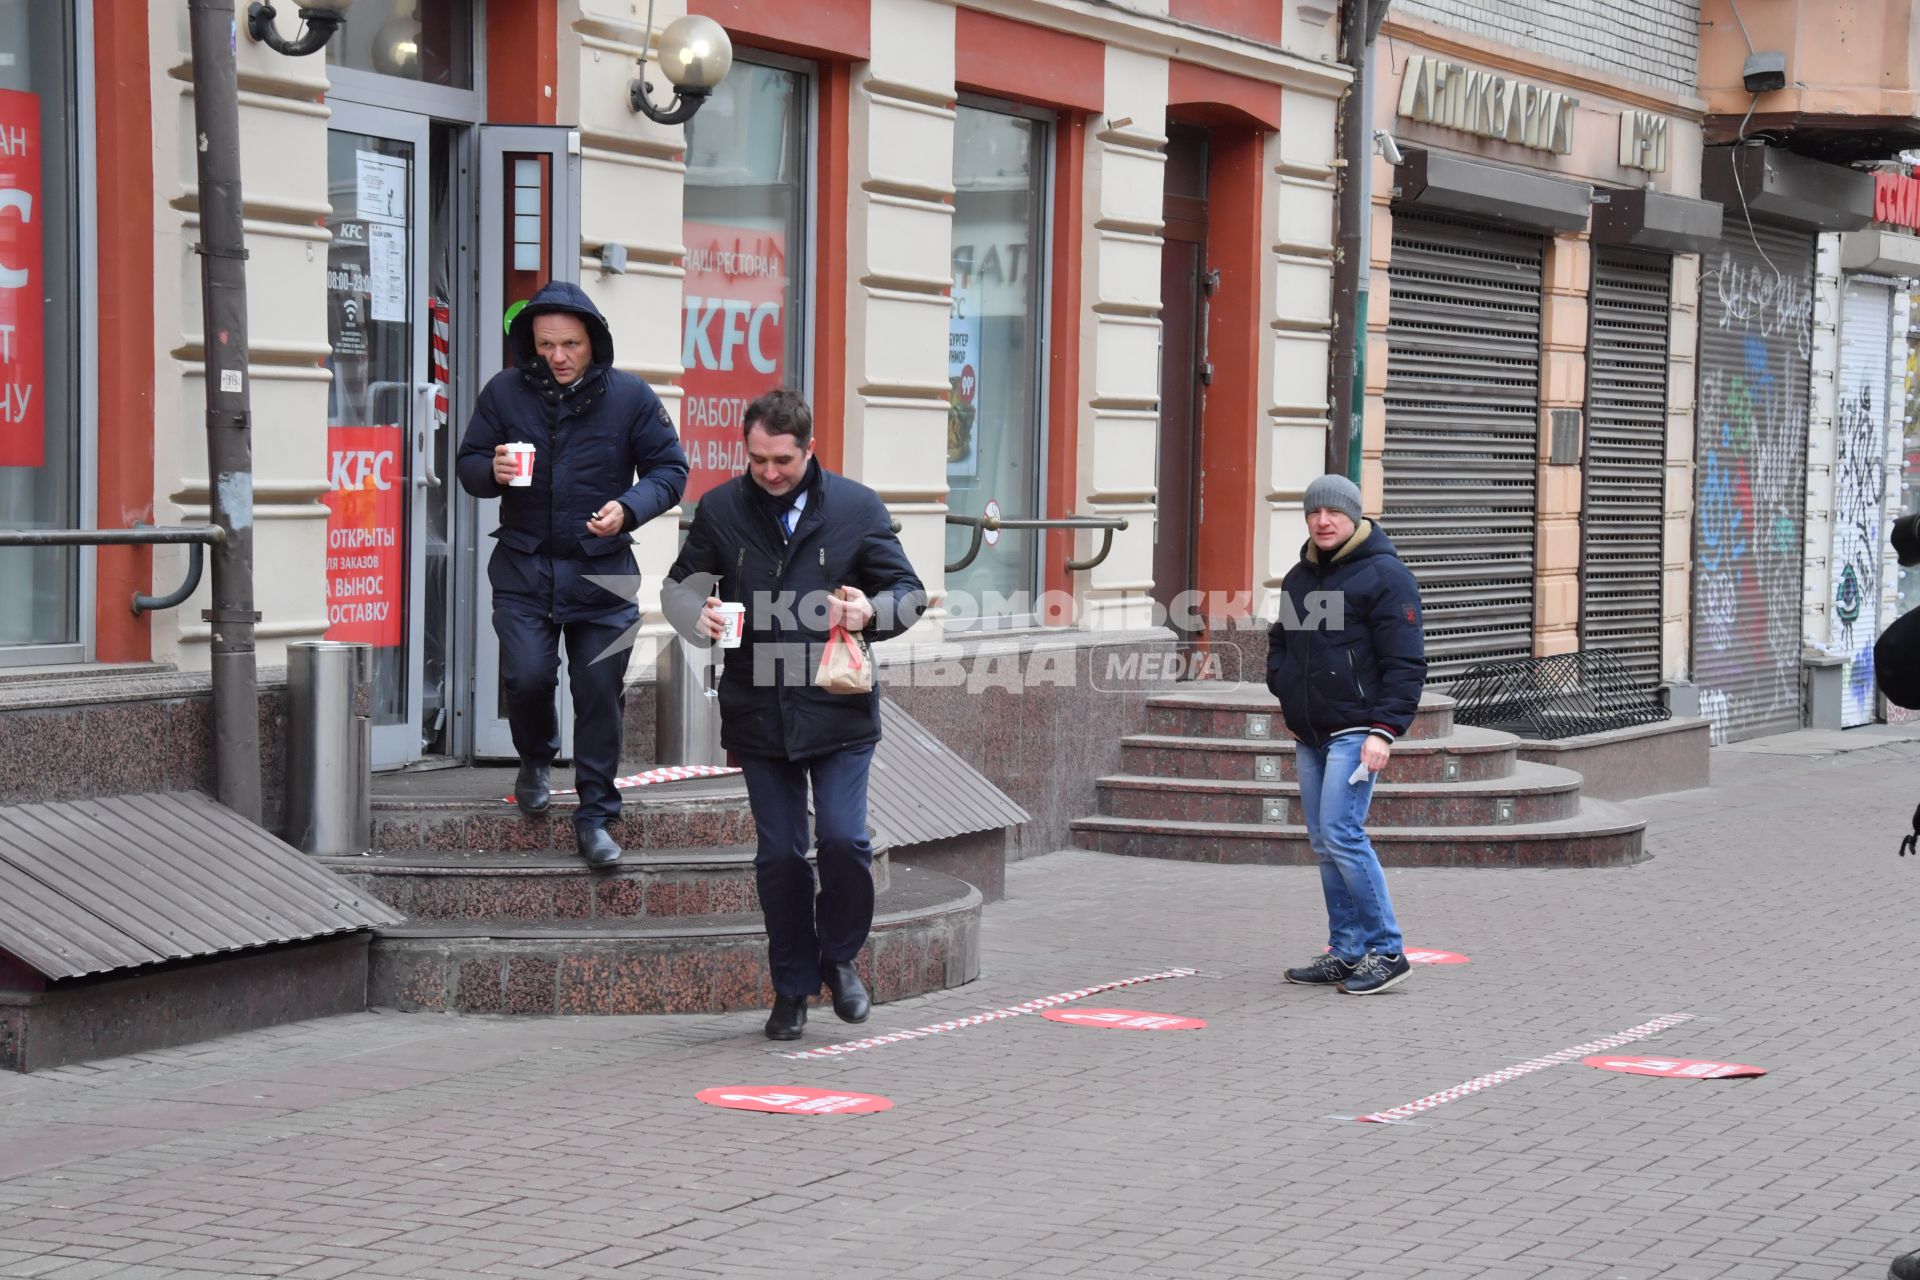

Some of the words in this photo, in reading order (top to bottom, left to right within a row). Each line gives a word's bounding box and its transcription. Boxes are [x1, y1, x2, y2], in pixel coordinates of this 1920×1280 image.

[1397, 55, 1579, 156] АНТИКВАРИАТ
[340, 223, 363, 240] KFC
[717, 251, 778, 280] РЕСТОРАН
[681, 295, 780, 374] KFC
[948, 332, 969, 349] БУРГЕР
[687, 396, 750, 428] РАБОТА
[330, 450, 393, 491] KFC
[330, 527, 395, 549] ОТКРЫТЫ
[326, 557, 338, 570] ЛЯ
[340, 555, 379, 570] ЗАКАЗОВ
[335, 576, 383, 597] ВЫНОС
[328, 601, 389, 625] ОСТАВКУ
